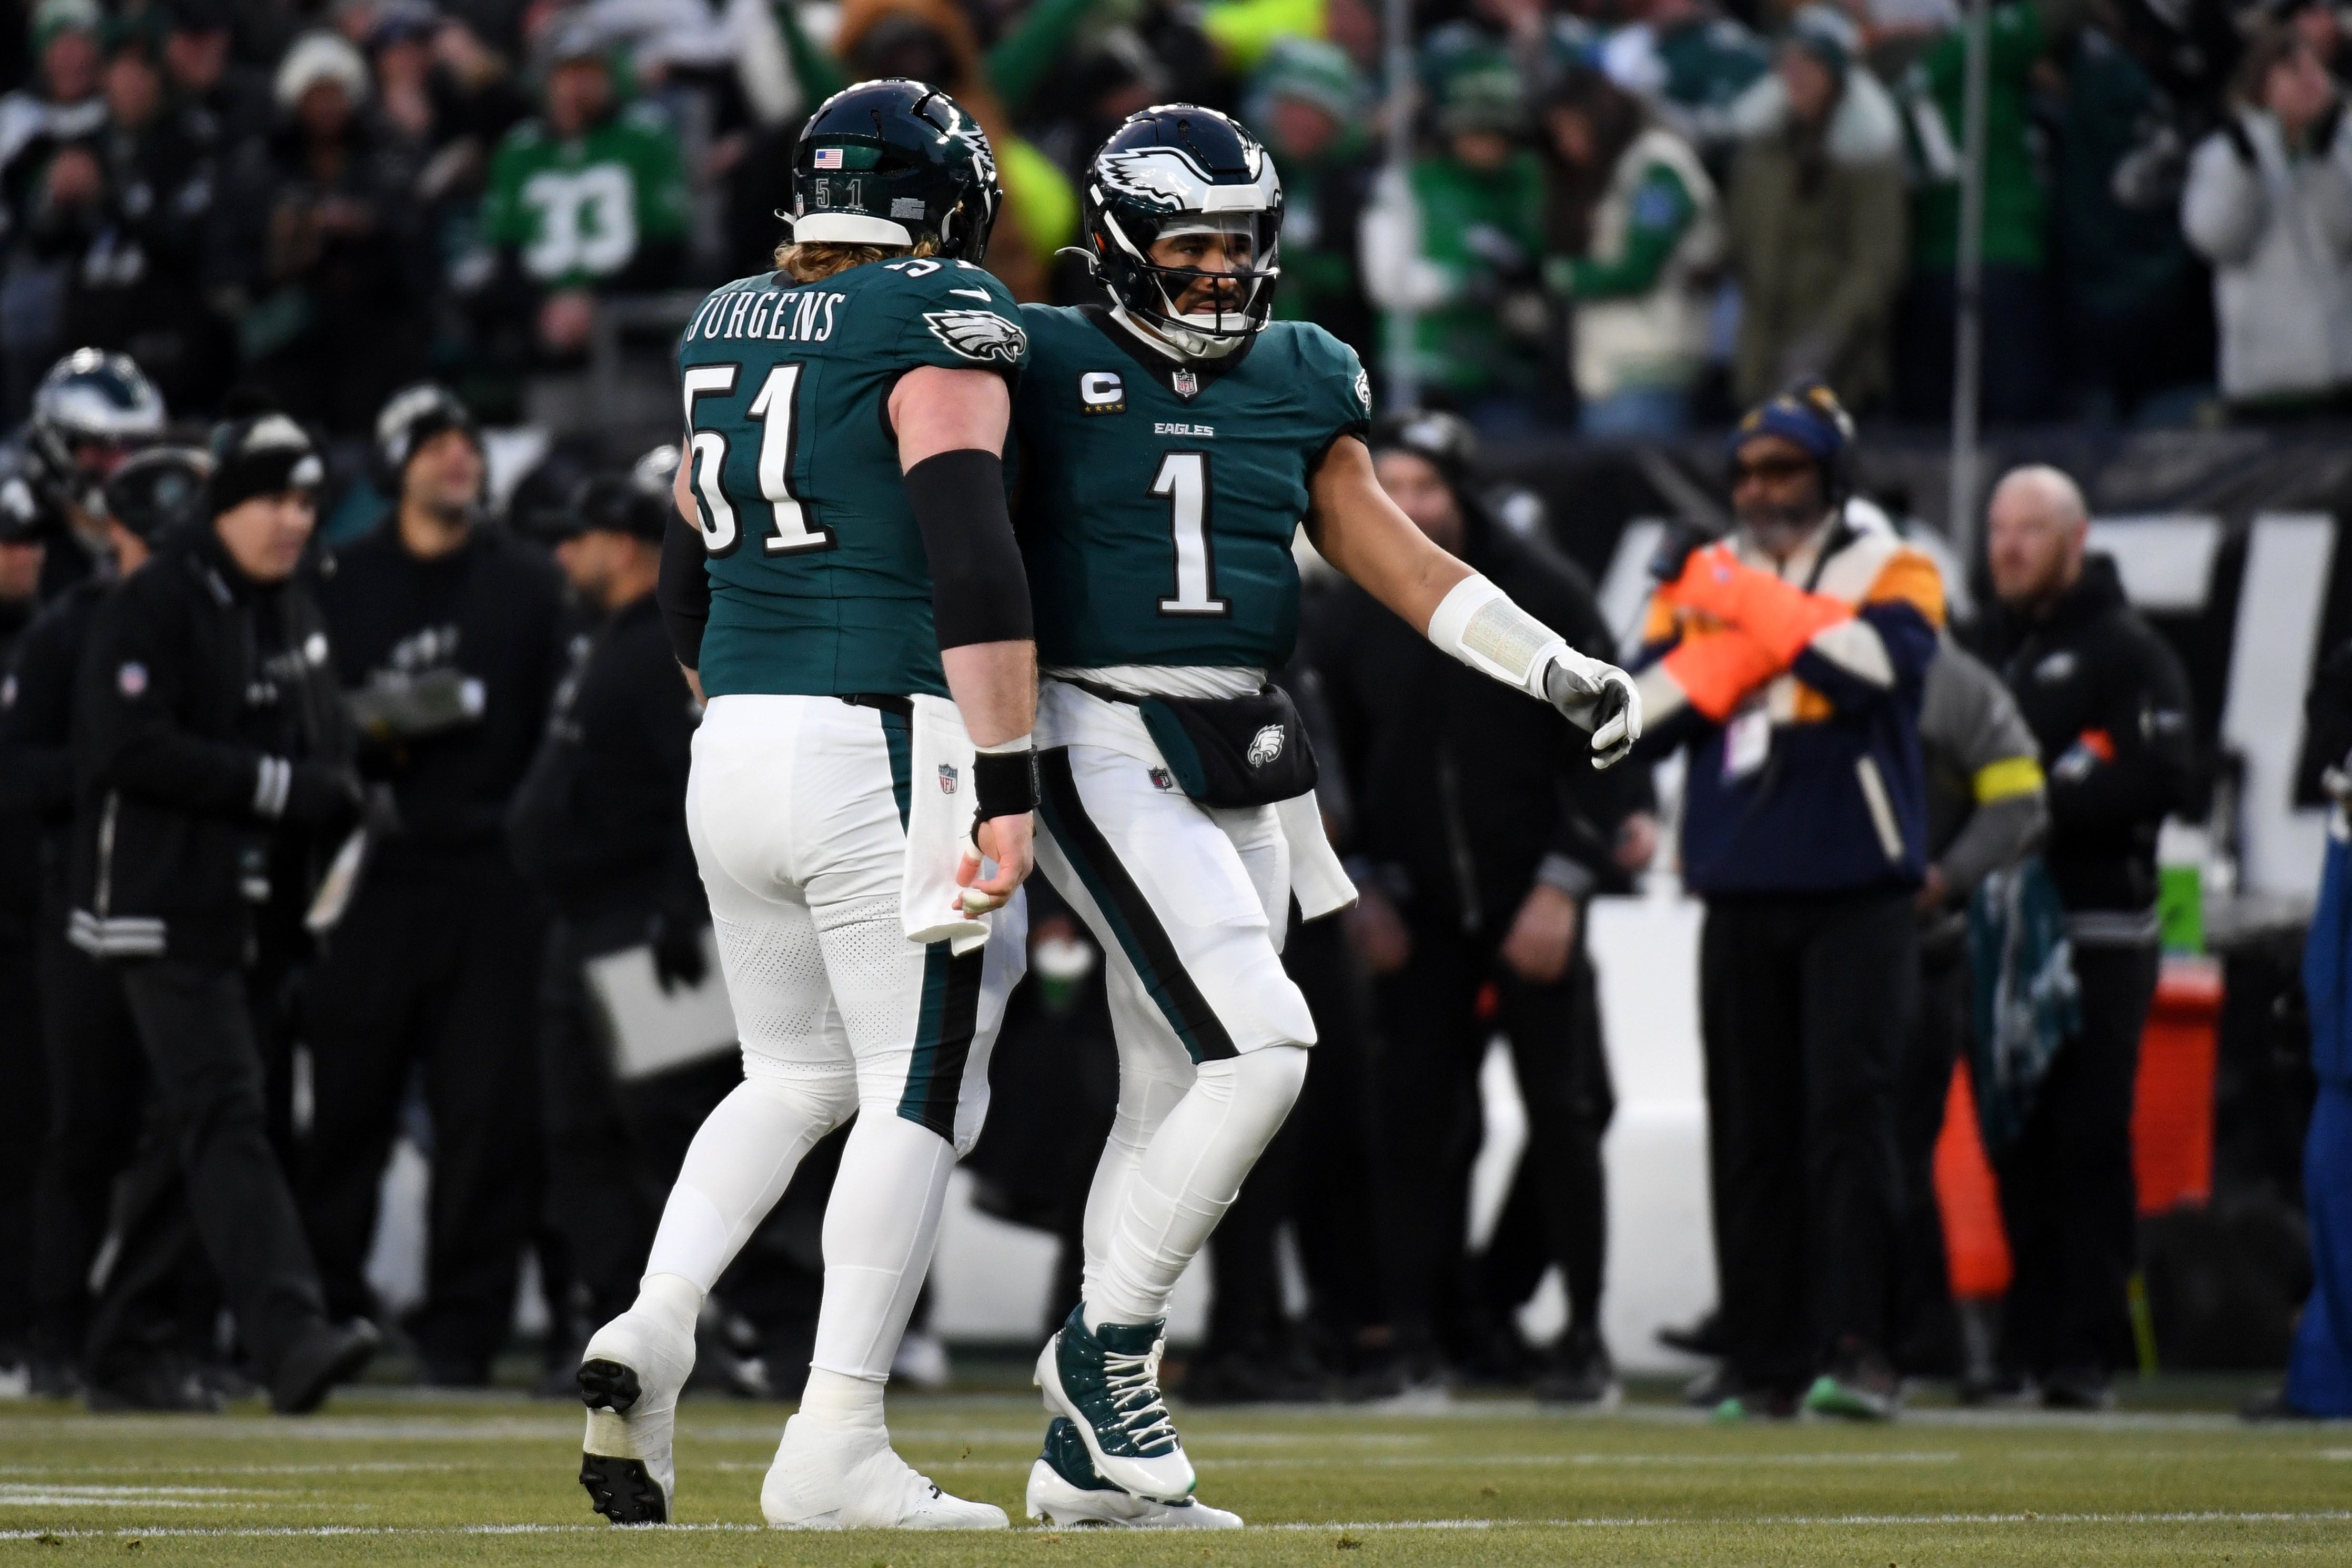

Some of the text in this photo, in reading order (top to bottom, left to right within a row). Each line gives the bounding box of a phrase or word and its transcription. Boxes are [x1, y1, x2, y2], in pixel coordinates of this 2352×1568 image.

[816, 178, 863, 208] 51
[882, 258, 985, 278] 5
[686, 291, 846, 342] JURGENS
[1081, 372, 1122, 404] C
[1179, 381, 1194, 391] NFL
[1154, 422, 1214, 436] EAGLES
[683, 362, 837, 559] 51
[1147, 450, 1230, 616] 1
[940, 775, 955, 791] NFL
